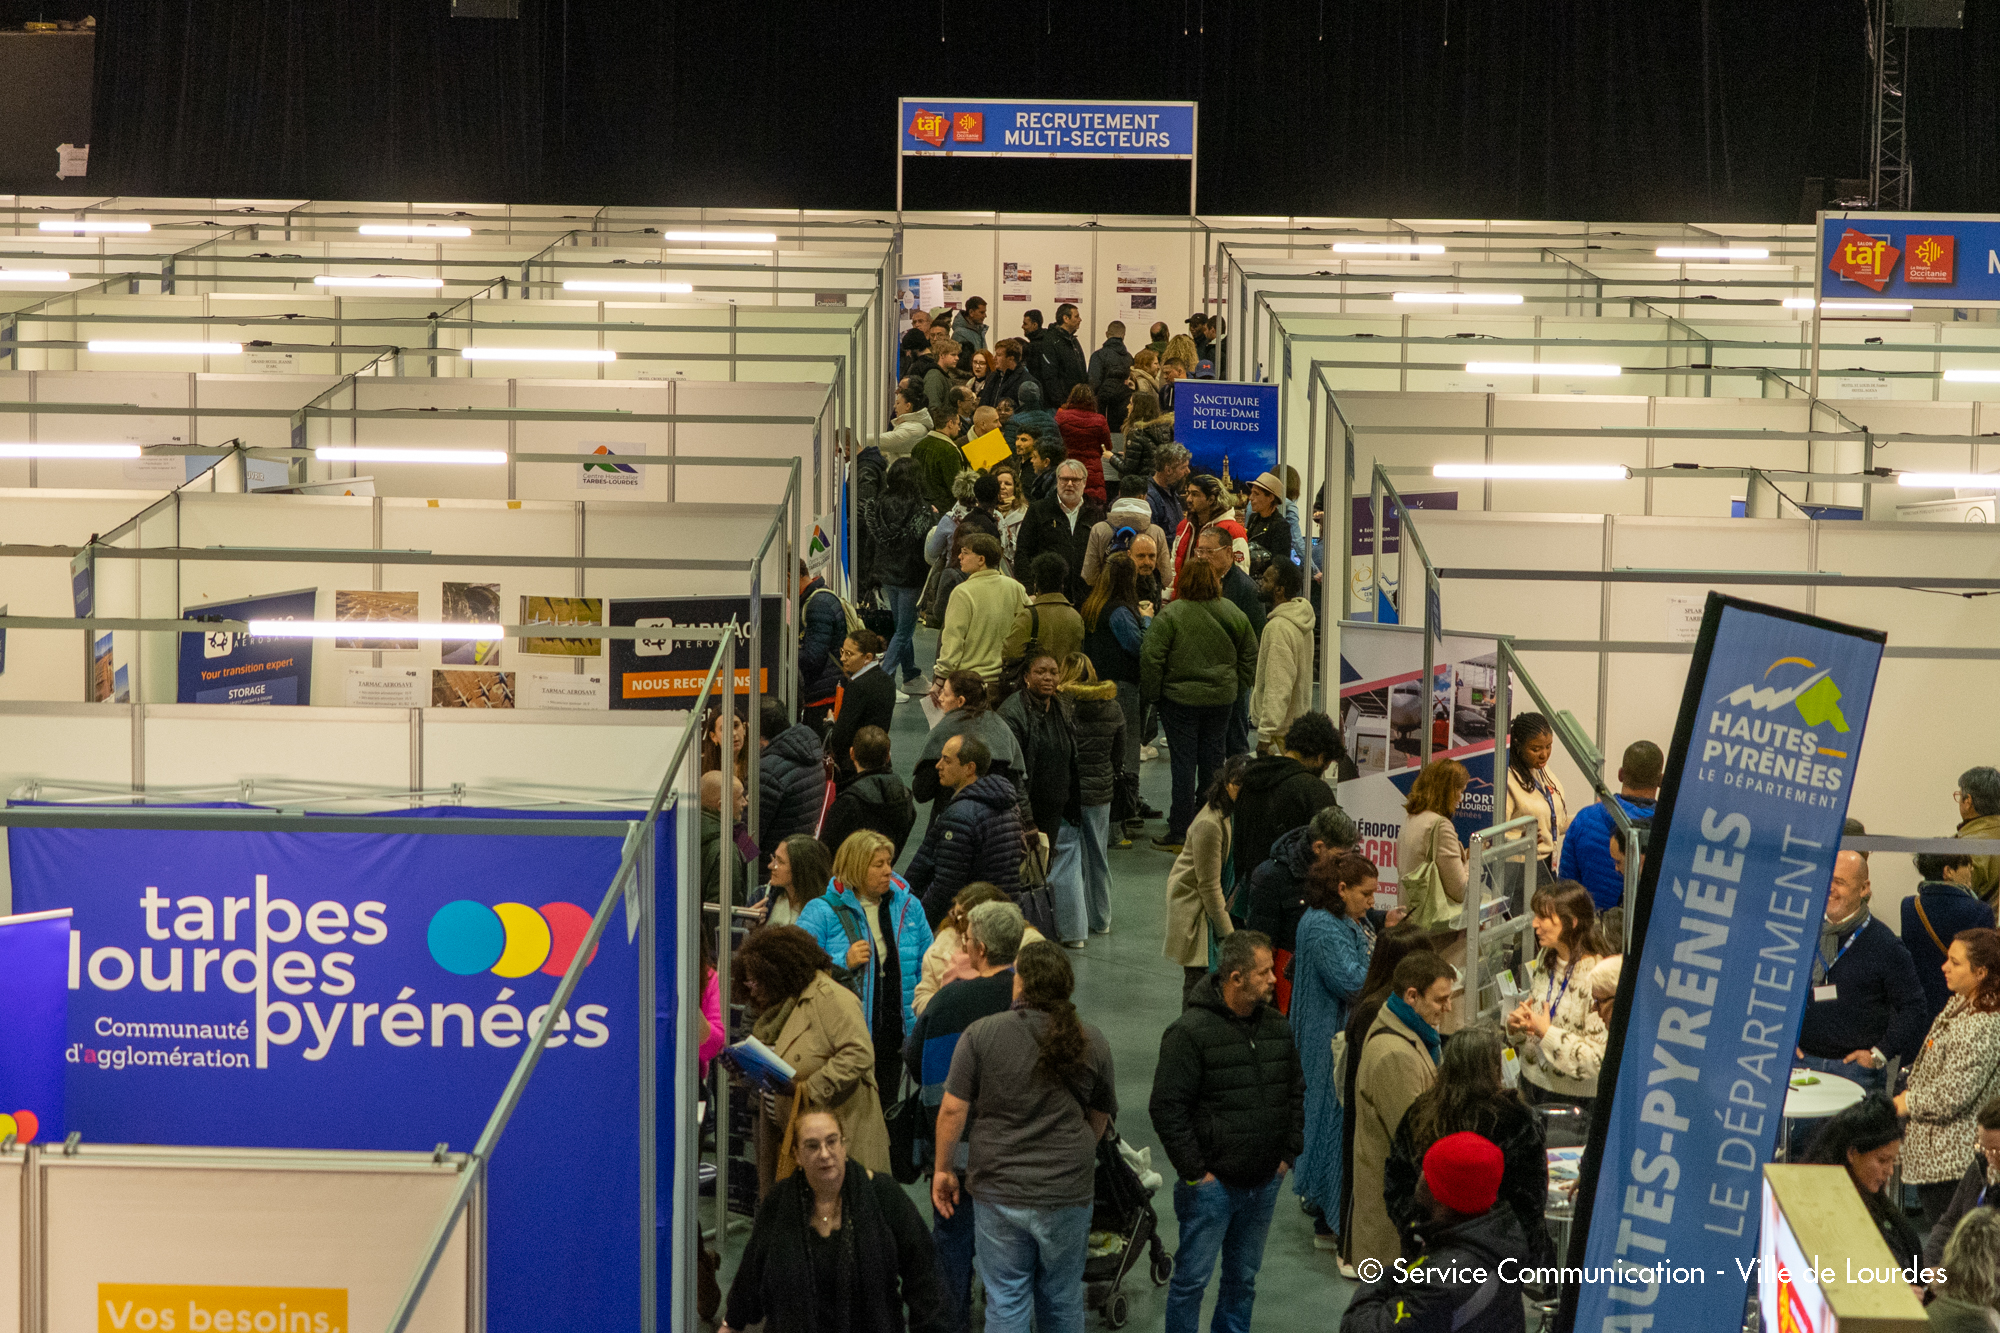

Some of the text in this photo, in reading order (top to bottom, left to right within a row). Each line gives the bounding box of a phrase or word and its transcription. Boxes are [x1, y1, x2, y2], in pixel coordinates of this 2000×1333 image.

[917, 115, 942, 137] taf
[1015, 112, 1160, 129] RECRUTEMENT
[1004, 130, 1170, 147] MULTI-SECTEURS
[1844, 241, 1887, 275] taf
[247, 471, 264, 481] UVRIR
[201, 658, 293, 680] Your transition expert
[632, 676, 750, 690] NOUS RECRTNS
[229, 685, 265, 699] STORAGE
[1709, 711, 1818, 756] HAUTES
[1703, 739, 1842, 790] PYRÉNÉES
[1698, 767, 1837, 809] LE DÉPARTEMENT
[1353, 818, 1400, 839] ÉROPO
[140, 874, 388, 944] tarbes
[68, 929, 355, 996] lourdes
[95, 1016, 249, 1040] Communauté
[256, 986, 609, 1068] pyrénées
[1704, 824, 1823, 1238] LE DÉPARTEMENT
[65, 1044, 250, 1070] d'agglomération
[1602, 806, 1751, 1333] AUTES-PYRÉNÉES
[106, 1300, 340, 1333] Vos besoins,
